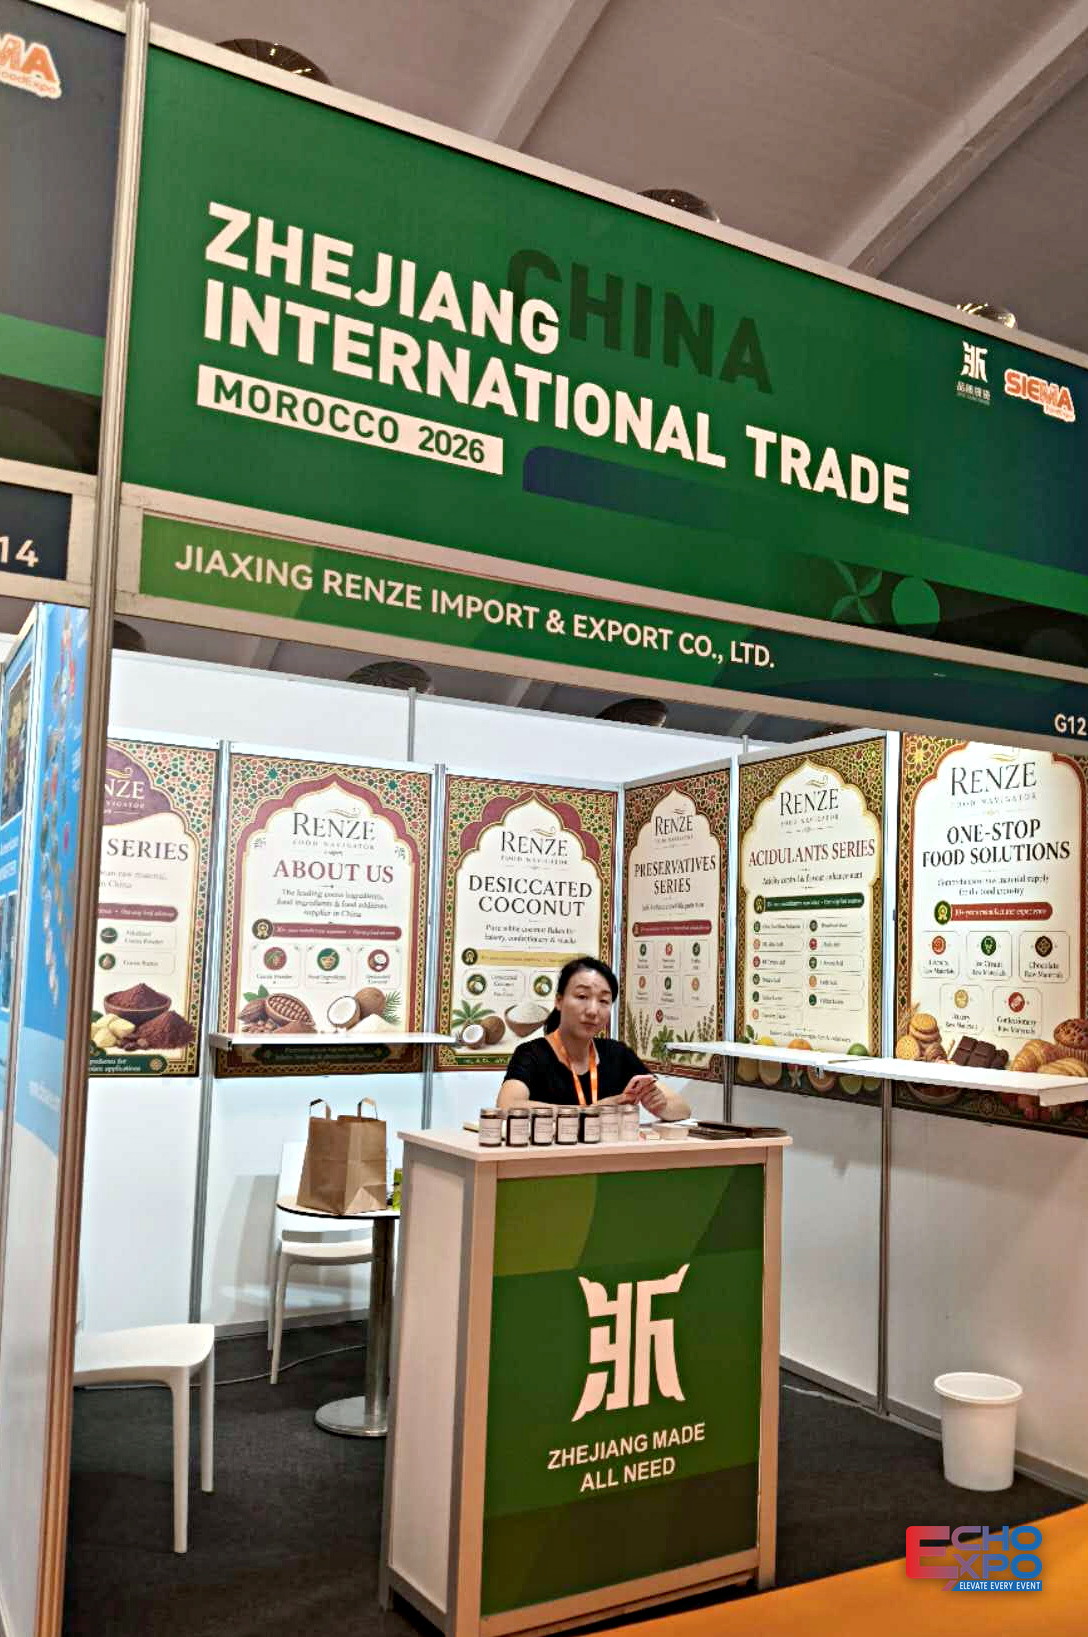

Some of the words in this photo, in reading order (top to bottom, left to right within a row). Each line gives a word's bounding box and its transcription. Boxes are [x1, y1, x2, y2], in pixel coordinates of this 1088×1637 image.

[205, 202, 560, 355] ZHEJIANG
[507, 249, 772, 394] CHINA
[203, 279, 726, 468] INTERNATIONAL
[746, 424, 910, 515] TRADE
[213, 375, 400, 443] MOROCCO
[418, 426, 485, 464] 2026
[175, 545, 313, 591] JIAXING
[323, 570, 422, 610] RENZE
[431, 589, 540, 630] IMPORT
[545, 608, 566, 635] &
[573, 613, 673, 652] EXPORT
[678, 632, 724, 665] CO.,
[730, 640, 775, 669] LTD.
[1054, 713, 1087, 736] G12
[951, 762, 1037, 796] RENZE
[780, 788, 839, 816] RENZE
[292, 812, 375, 841] RENZE
[655, 815, 693, 837] RENZE
[947, 819, 1041, 845] ONE-STOP
[107, 838, 189, 862] SERIES
[501, 831, 568, 856] RENZE
[749, 844, 829, 867] ACIDULANTS
[832, 839, 875, 861] SERIES
[922, 849, 965, 868] FOOD
[970, 841, 1071, 865] SOLUTIONS
[273, 859, 360, 881] ABOUT
[366, 864, 394, 884] US
[634, 855, 716, 878] PRESERVATIVES
[469, 874, 592, 898] DESICCATED
[654, 878, 691, 895] SERIES
[478, 896, 585, 917] COCONUT
[547, 1434, 648, 1470] ZHEJIANG
[653, 1422, 706, 1450] MADE
[580, 1470, 619, 1493] ALL
[623, 1456, 676, 1484] NEED
